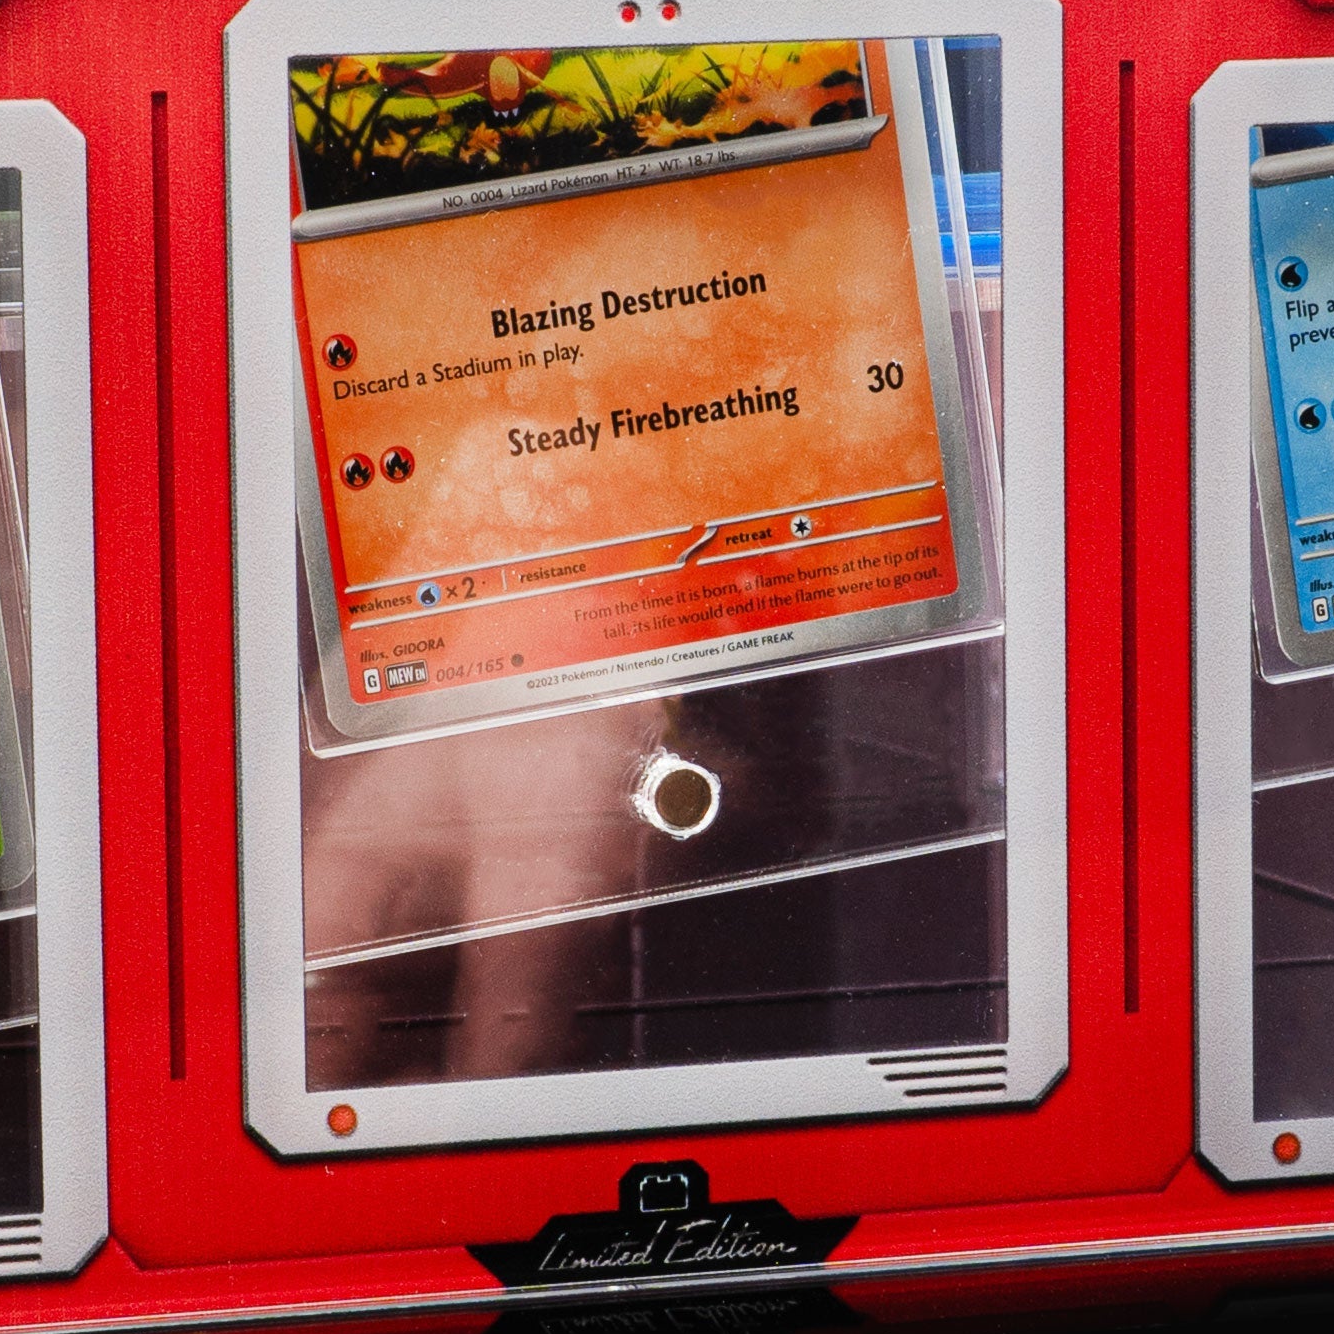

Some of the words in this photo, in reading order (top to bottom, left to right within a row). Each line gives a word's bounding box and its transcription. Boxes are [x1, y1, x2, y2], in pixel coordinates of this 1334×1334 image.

[442, 196, 466, 209] NO.
[471, 188, 503, 205] 0004
[511, 180, 547, 198] Lizard
[552, 170, 609, 193] Pokémon
[616, 166, 635, 180] HT:
[659, 156, 682, 172] WT:
[688, 152, 715, 169] 18.7
[718, 148, 737, 163] lbs.
[491, 299, 595, 339] Blazing
[602, 271, 767, 319] Destruction
[1285, 298, 1319, 321] Flip
[333, 371, 409, 401] Discard
[415, 374, 427, 386] a
[433, 353, 512, 383] Stadium
[519, 348, 536, 367] in
[543, 340, 584, 368] play.
[508, 419, 600, 457] Steady
[611, 385, 800, 440] Firebreathing
[867, 361, 904, 393] 30
[348, 593, 412, 615] weakness
[519, 562, 586, 583] resistance
[725, 528, 772, 546] retreat
[1317, 604, 1325, 617] G
[393, 638, 445, 657] GIDORA
[562, 665, 610, 682] Pokémon
[617, 656, 664, 672] Nintendo
[672, 646, 720, 663] Creatures
[727, 638, 760, 652] GAME
[763, 631, 794, 646] FREAK
[367, 674, 376, 688] G
[538, 1220, 666, 1270] Limited
[665, 1214, 797, 1264] Edition
